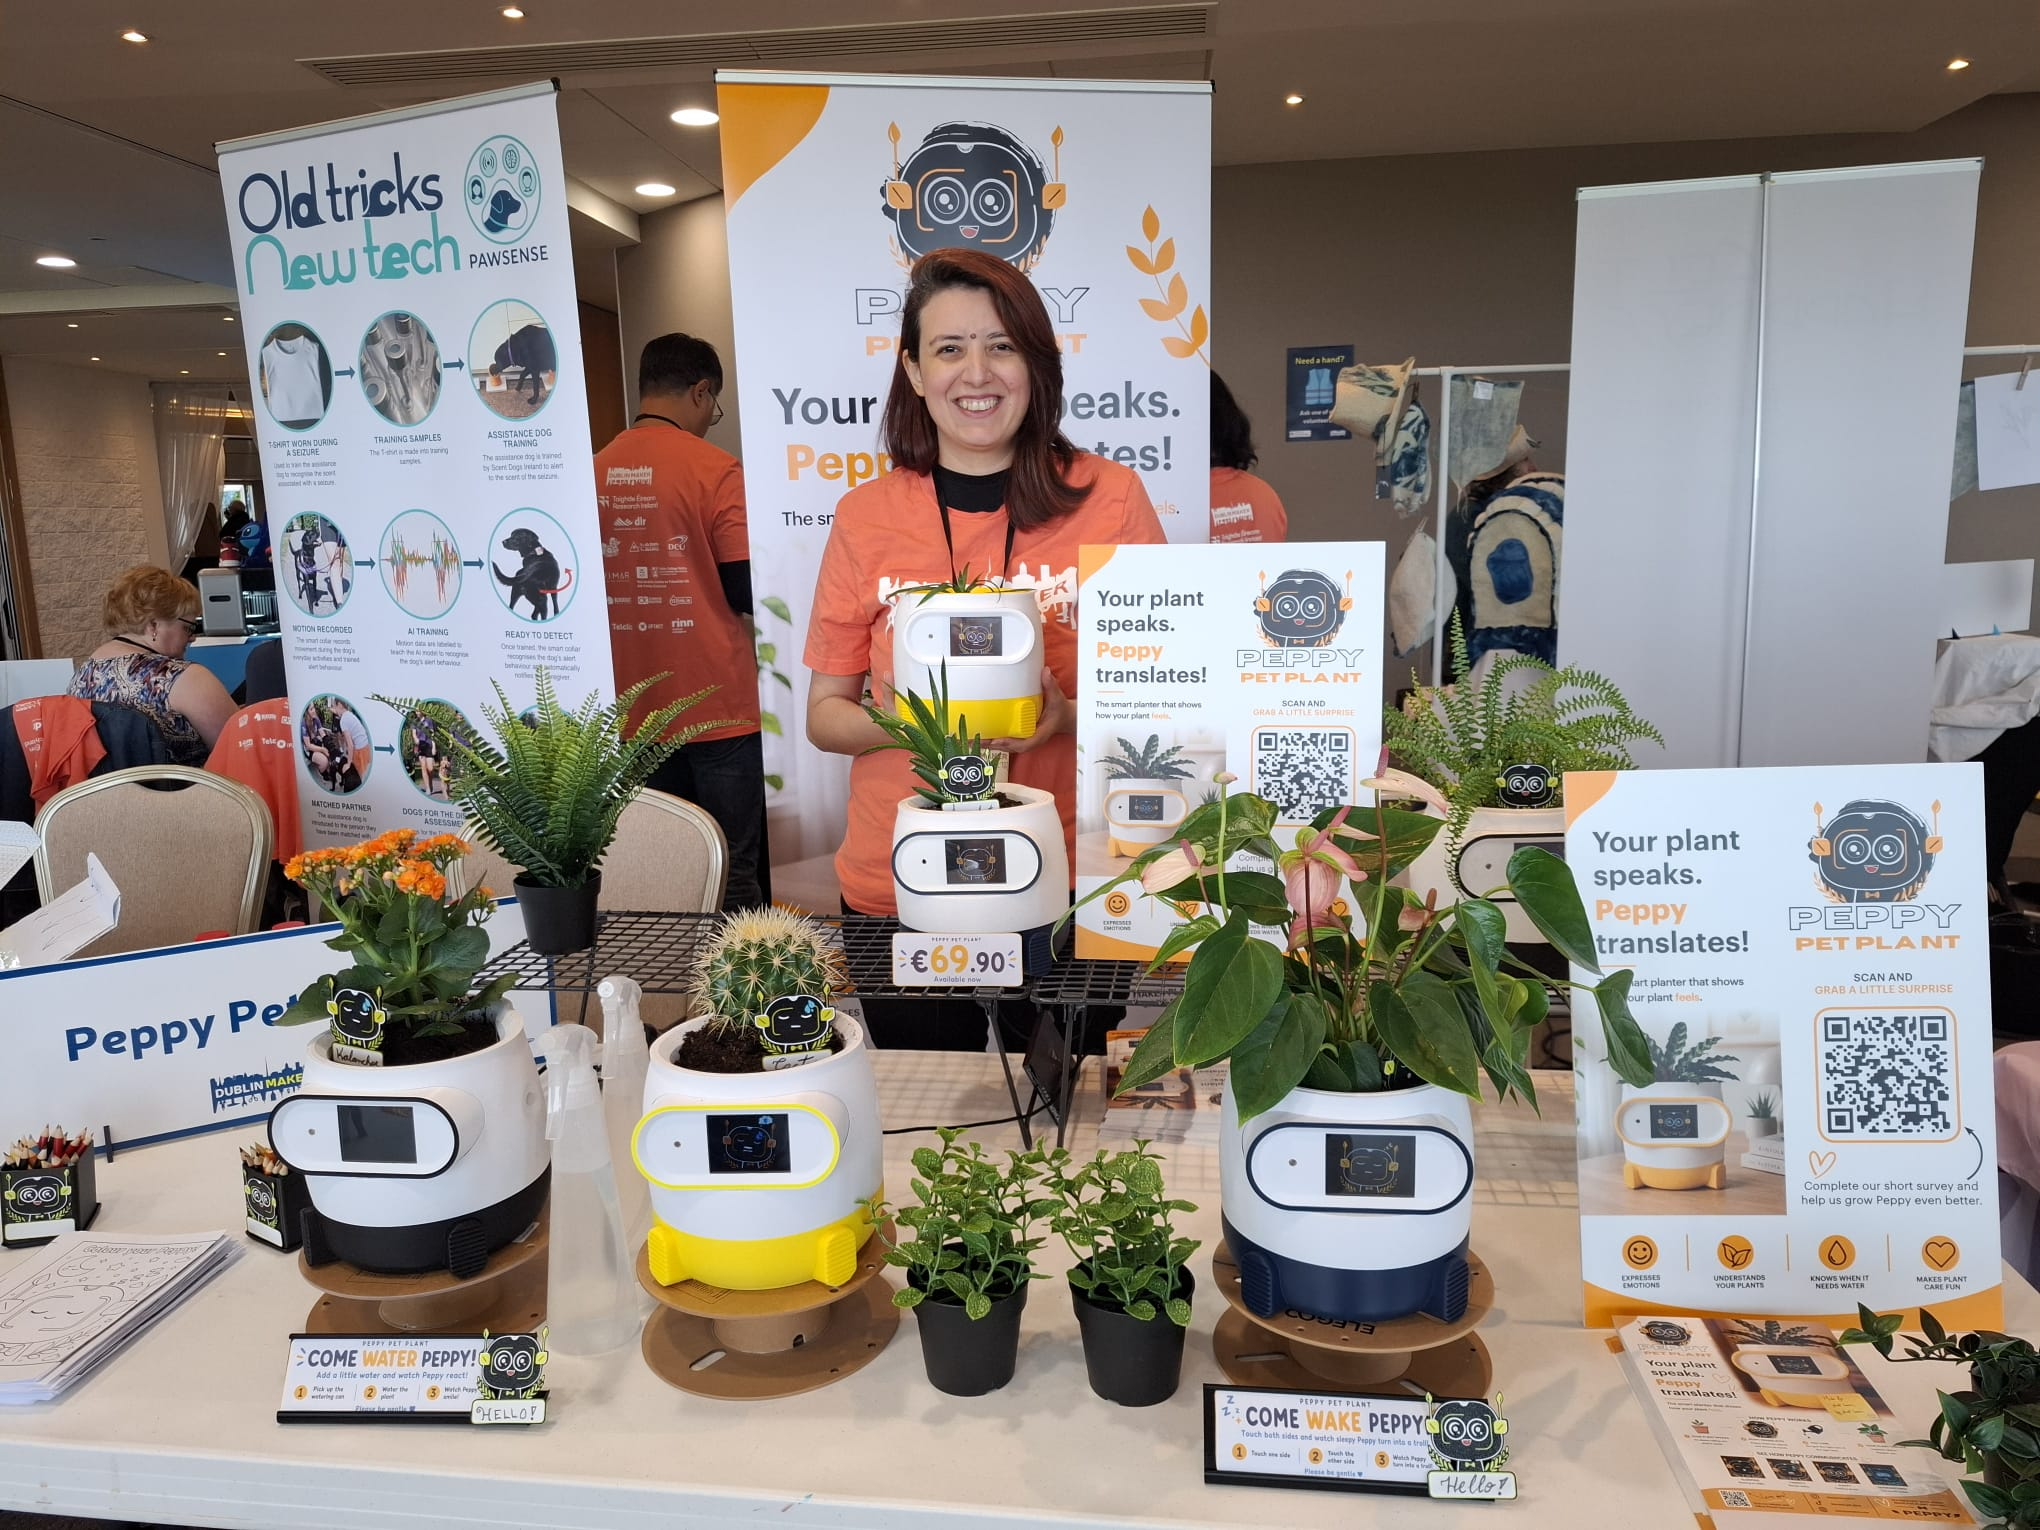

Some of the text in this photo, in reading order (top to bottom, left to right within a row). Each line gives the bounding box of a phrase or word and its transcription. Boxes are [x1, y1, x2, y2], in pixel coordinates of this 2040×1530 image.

[239, 151, 444, 235] Old tricks
[363, 212, 461, 280] tech
[469, 245, 549, 269] PAWSENSE
[1295, 357, 1315, 365] Need
[1321, 355, 1345, 364] hand?
[771, 380, 1181, 425] Your eaks.
[374, 433, 442, 444] TRAINING SAMPLES
[487, 428, 553, 439] ASSISTANCE DOG
[268, 438, 339, 449] T-SHIRT WORN DURING
[503, 439, 539, 448] TRAINING
[292, 448, 320, 456] SEIZURE
[787, 444, 893, 488] Pep
[634, 516, 647, 527] dlr
[781, 511, 814, 526] The
[1097, 589, 1204, 610] Your plant
[671, 618, 694, 628] rinn
[1096, 615, 1175, 636] speaks.
[292, 625, 353, 634] MOTION RECORDED
[407, 628, 449, 636] AI TRAINING
[505, 630, 574, 640] READY TO DETECT
[1097, 641, 1163, 662] Peppy
[1236, 649, 1364, 668] PEPPY
[1096, 665, 1207, 684] translates!
[1240, 672, 1362, 684] PET PLANT
[1095, 700, 1110, 708] The
[1110, 700, 1132, 708] smart
[1133, 700, 1160, 709] planter
[1161, 700, 1177, 708] that
[1281, 700, 1326, 708] SCAN AND
[1131, 712, 1150, 720] plant
[1252, 708, 1356, 717] GRAB A LITTLE SURPRISE
[311, 799, 372, 812] MATCHED PARTNER
[402, 808, 454, 819] DOGS FOR THE
[1592, 828, 1741, 857] Your plant
[1593, 862, 1702, 891] speaks.
[1595, 898, 1688, 926] Peppy
[1788, 903, 1963, 931] PEPPY
[1596, 930, 1750, 955] translates!
[1795, 935, 1961, 951] PET PLANT
[910, 944, 1005, 973] €69.90
[1650, 976, 1745, 988] planter that shows
[1853, 972, 1913, 982] SCAN AND
[1814, 984, 1953, 995] GRAB A LITTLE SURPRISE
[1647, 992, 1703, 1004] plant feels.
[65, 1014, 216, 1062] Peppy
[215, 1073, 304, 1099] DUBLIN MAKE
[1803, 1180, 1980, 1194] Complete our short survey and
[1801, 1195, 1983, 1207] help us grow Peppy even better.
[1713, 1274, 1766, 1282] UNDERSTANDS
[1815, 1282, 1839, 1290] NEEDS
[307, 1349, 476, 1368] COME WATER PEPPY!
[1645, 1359, 1718, 1369] Your plant
[316, 1371, 331, 1379] Add
[339, 1371, 358, 1379] little
[382, 1371, 396, 1379] and
[398, 1371, 420, 1379] watch
[422, 1372, 443, 1381] Peppy
[446, 1371, 469, 1379] react!
[1650, 1369, 1705, 1378] speaks.
[1655, 1378, 1702, 1388] Peppy
[1660, 1388, 1738, 1399] translates!
[1299, 1398, 1372, 1408] PEPPY PET PLANT
[476, 1405, 537, 1422] HELLO!
[1245, 1406, 1300, 1429] COME
[1305, 1409, 1363, 1433] WAKE
[1241, 1430, 1406, 1446] Touch both sides and watch sleepy Peppy turn into
[1440, 1474, 1509, 1496] Hello!
